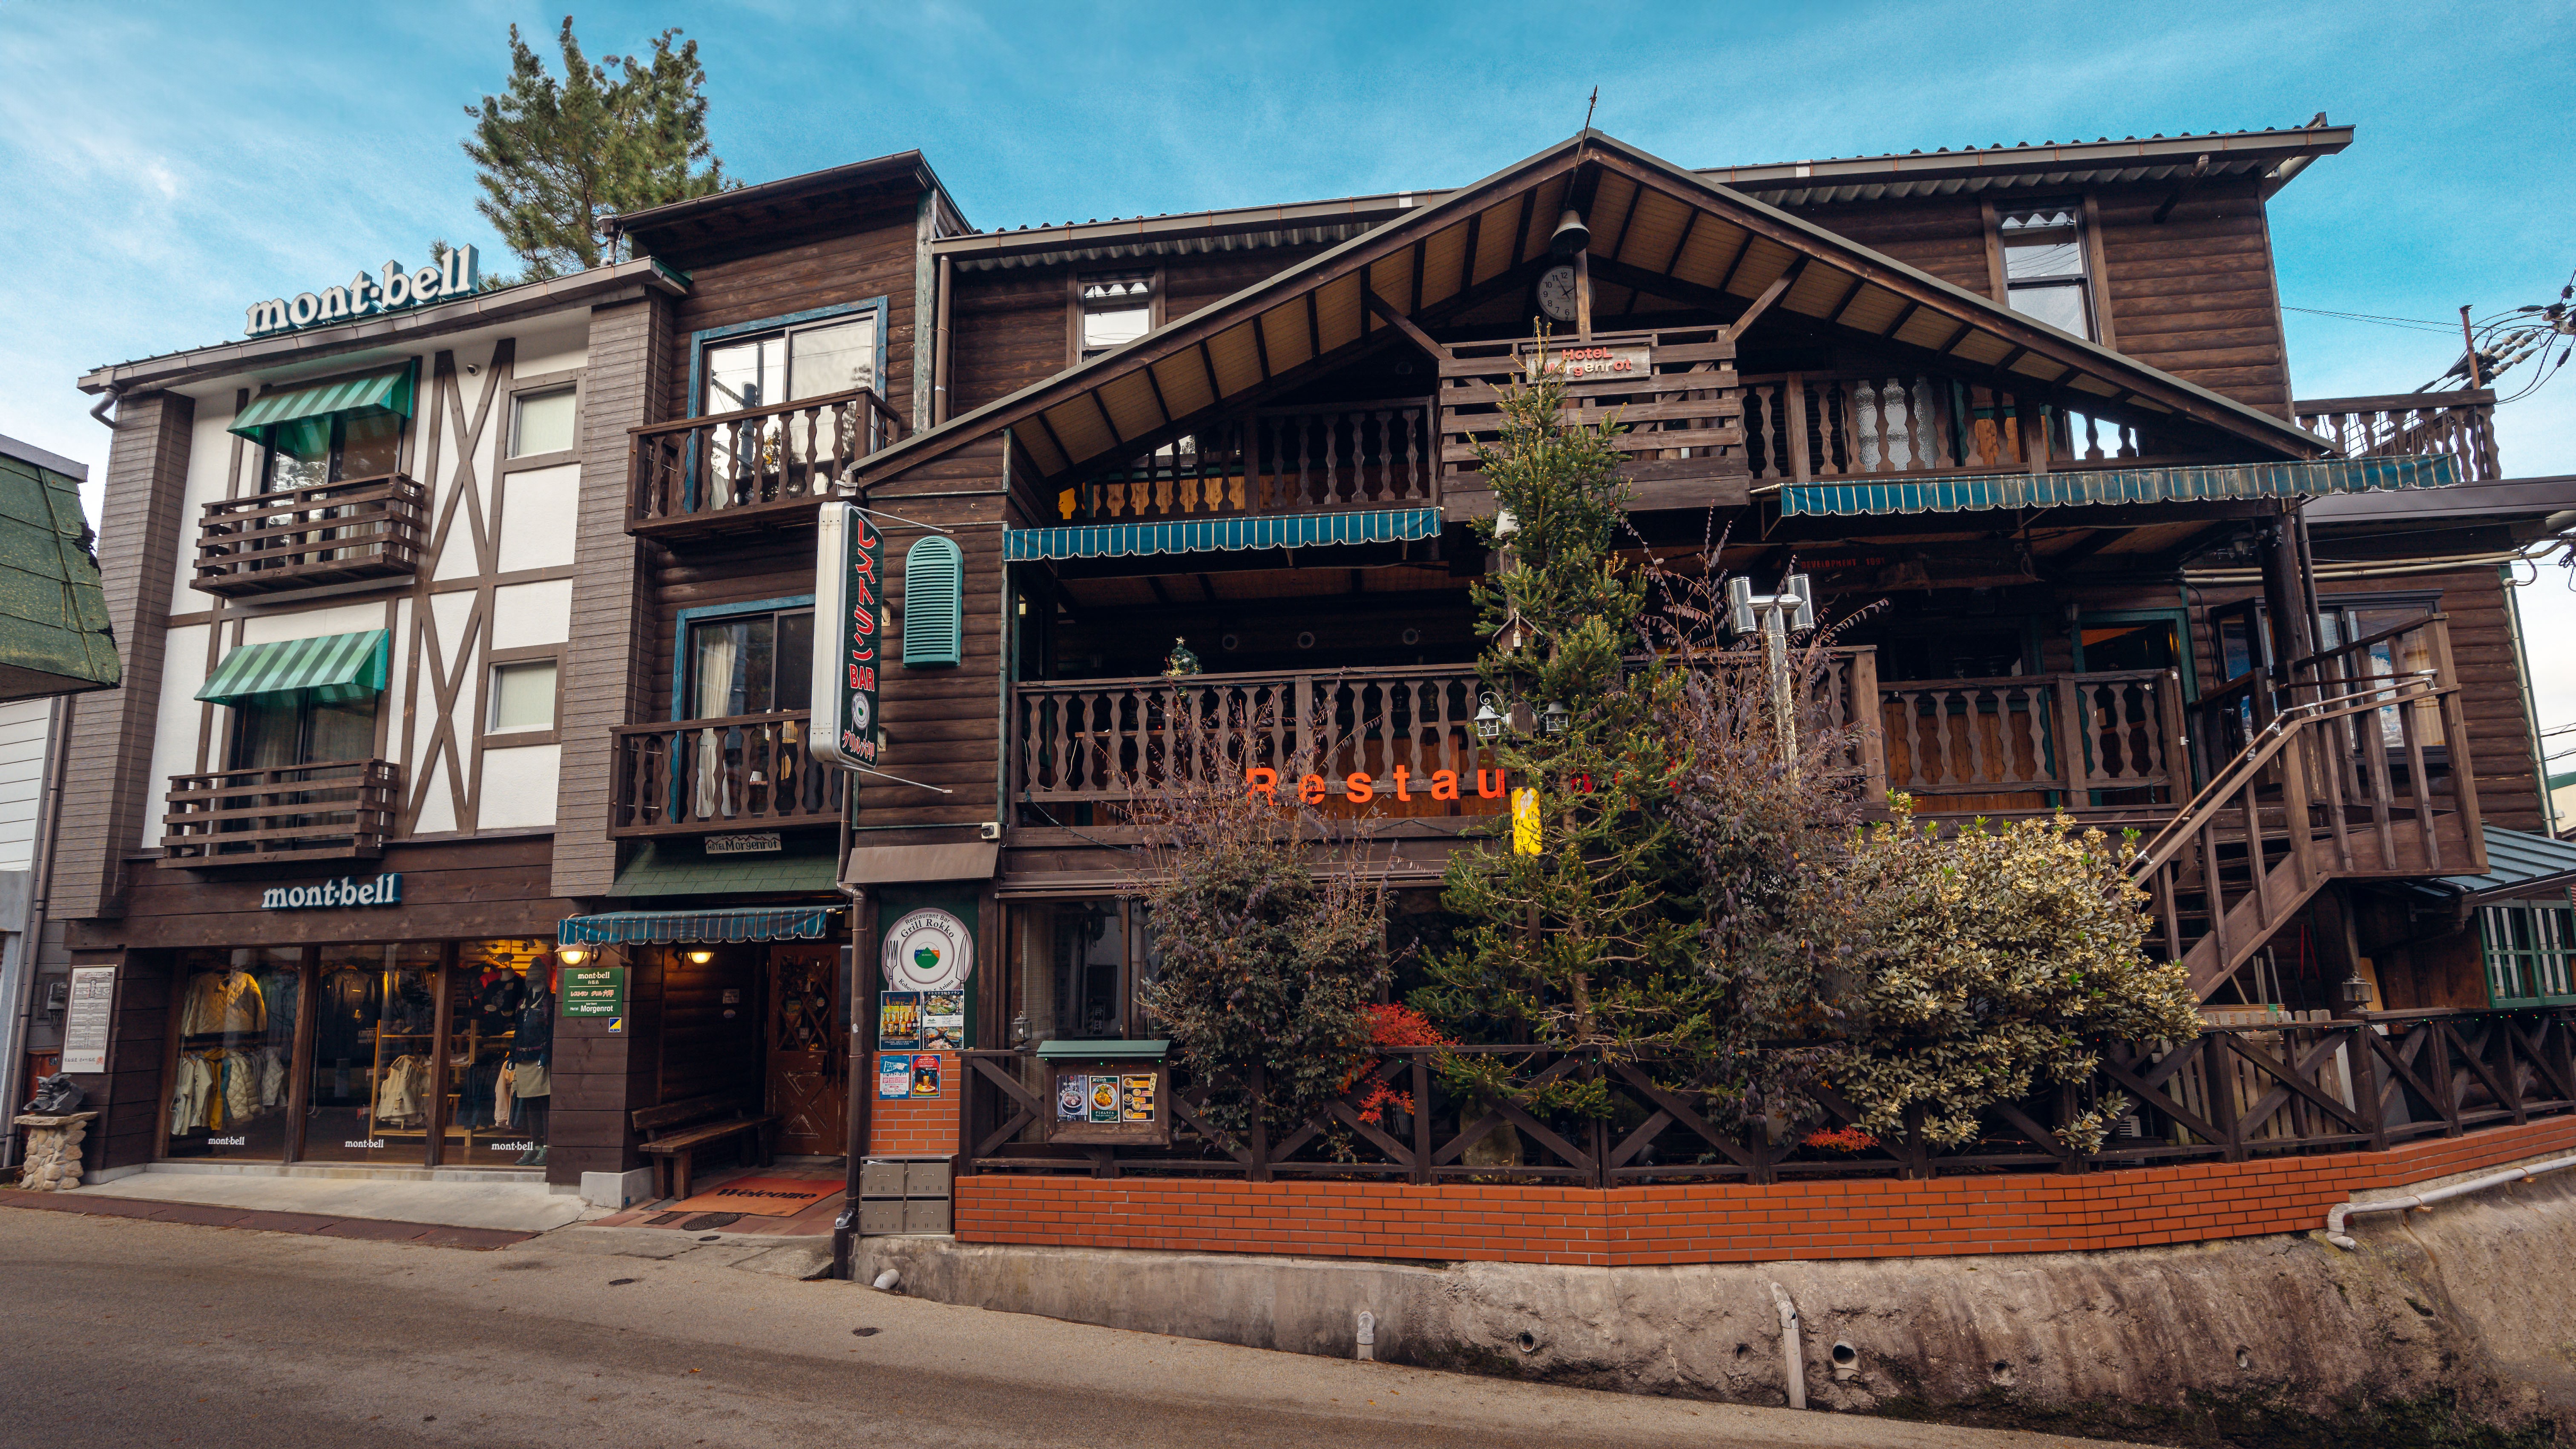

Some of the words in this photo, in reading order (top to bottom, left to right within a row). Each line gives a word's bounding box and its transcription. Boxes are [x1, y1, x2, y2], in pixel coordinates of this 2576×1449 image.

[852, 518, 877, 661] レストラン
[850, 663, 875, 692] BAR
[842, 729, 874, 761] グリル六甲
[726, 840, 777, 851] Morgenrot
[905, 914, 939, 925] Restaurant
[901, 920, 922, 937] Grill
[926, 919, 954, 937] Rokko
[939, 980, 954, 991] Arima
[581, 1005, 613, 1013] Morgenrot
[716, 1189, 817, 1199] Welcome
